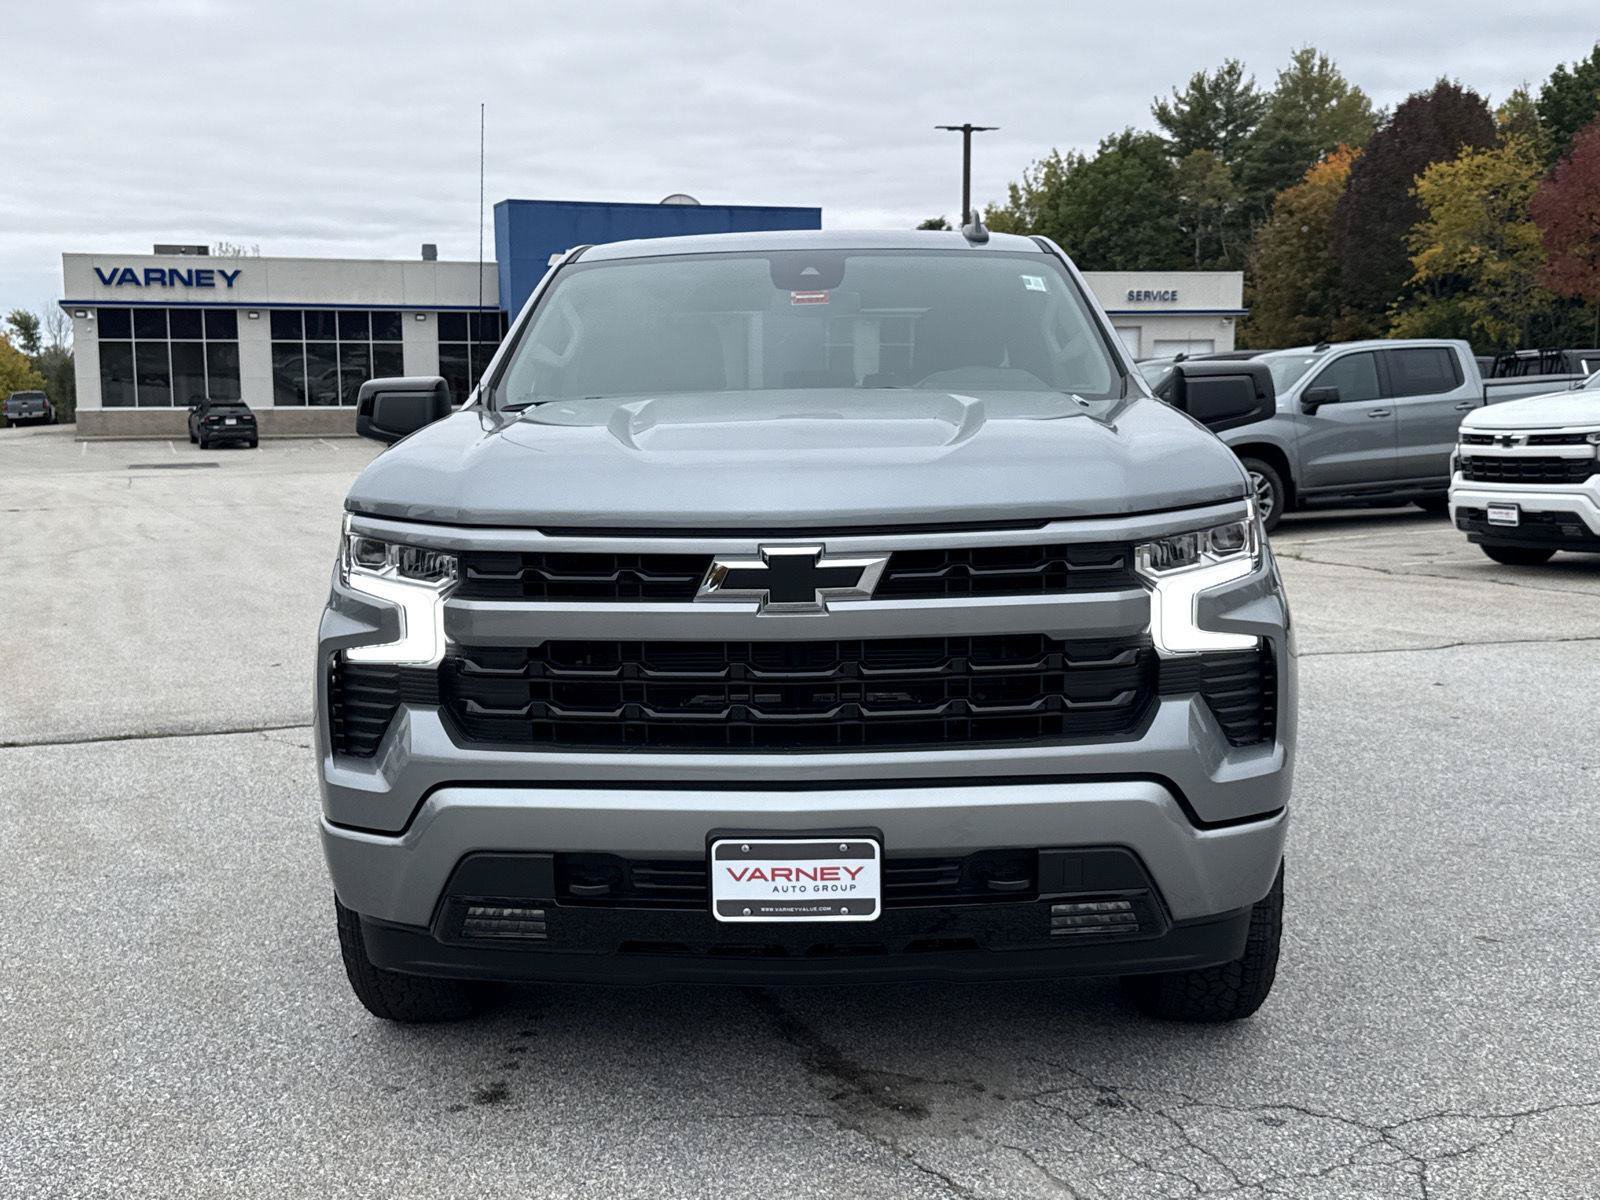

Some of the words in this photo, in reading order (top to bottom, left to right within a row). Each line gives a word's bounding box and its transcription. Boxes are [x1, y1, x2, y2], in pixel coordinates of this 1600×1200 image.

[93, 267, 242, 288] VARNEY
[1127, 290, 1178, 302] SERVICE
[726, 866, 864, 882] VARNEY
[772, 885, 807, 893] AUTO
[813, 884, 857, 893] GROUP
